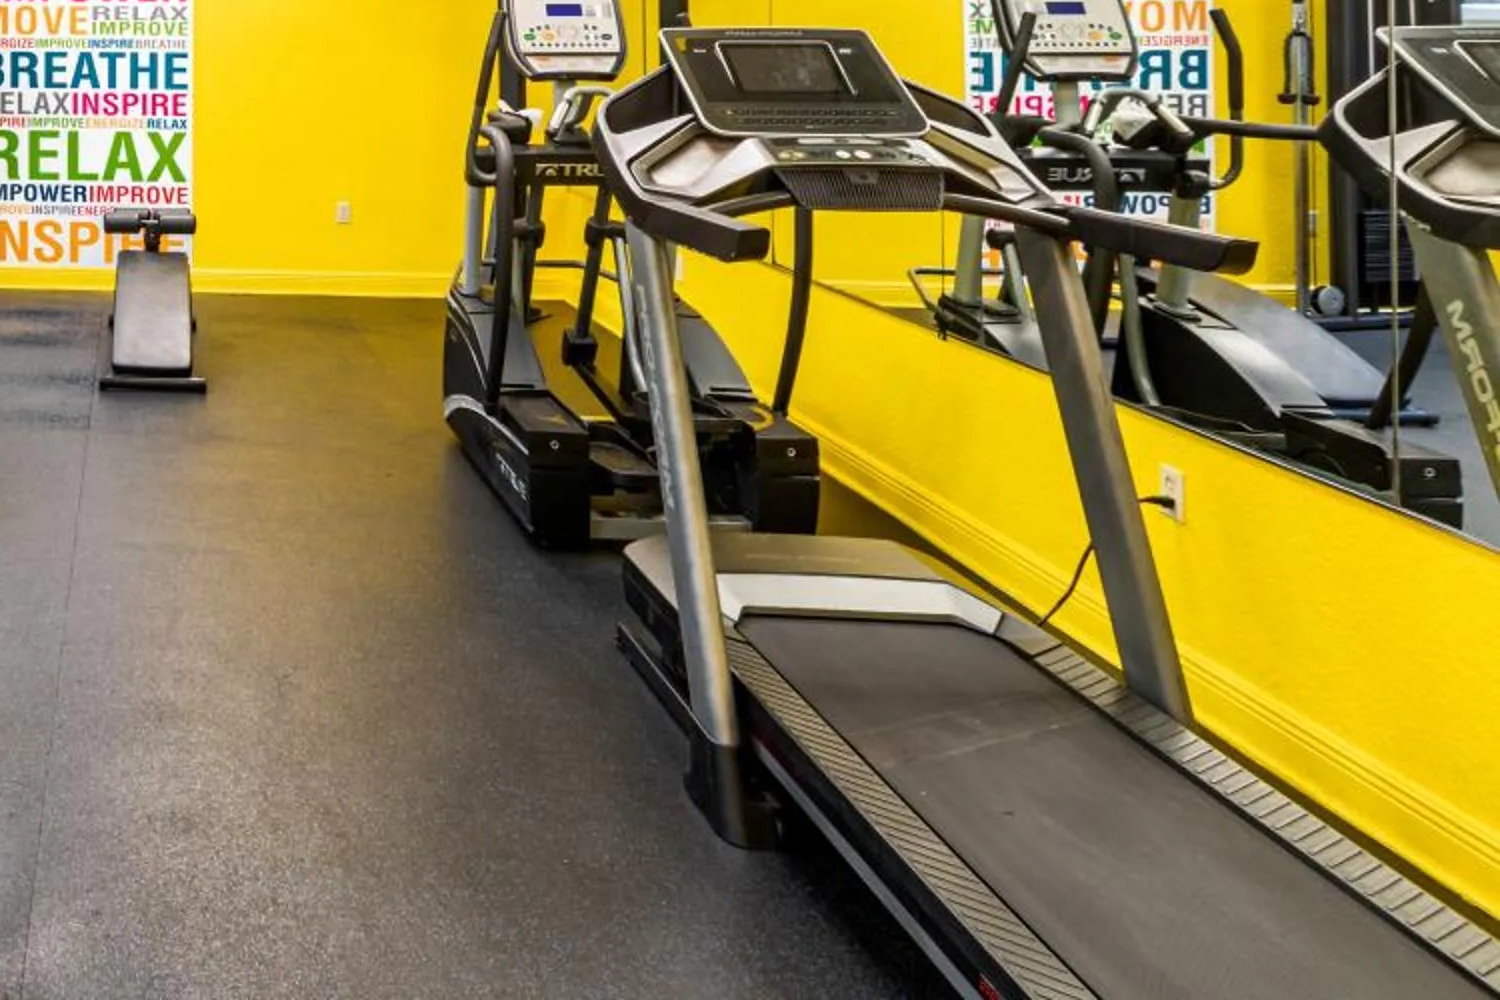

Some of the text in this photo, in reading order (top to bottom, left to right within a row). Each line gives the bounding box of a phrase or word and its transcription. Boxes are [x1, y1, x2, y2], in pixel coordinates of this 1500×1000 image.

[91, 5, 188, 21] RELAX
[91, 21, 189, 36] IMPROVE
[71, 92, 188, 117] INSPIRE
[89, 184, 189, 205] IMPROVE
